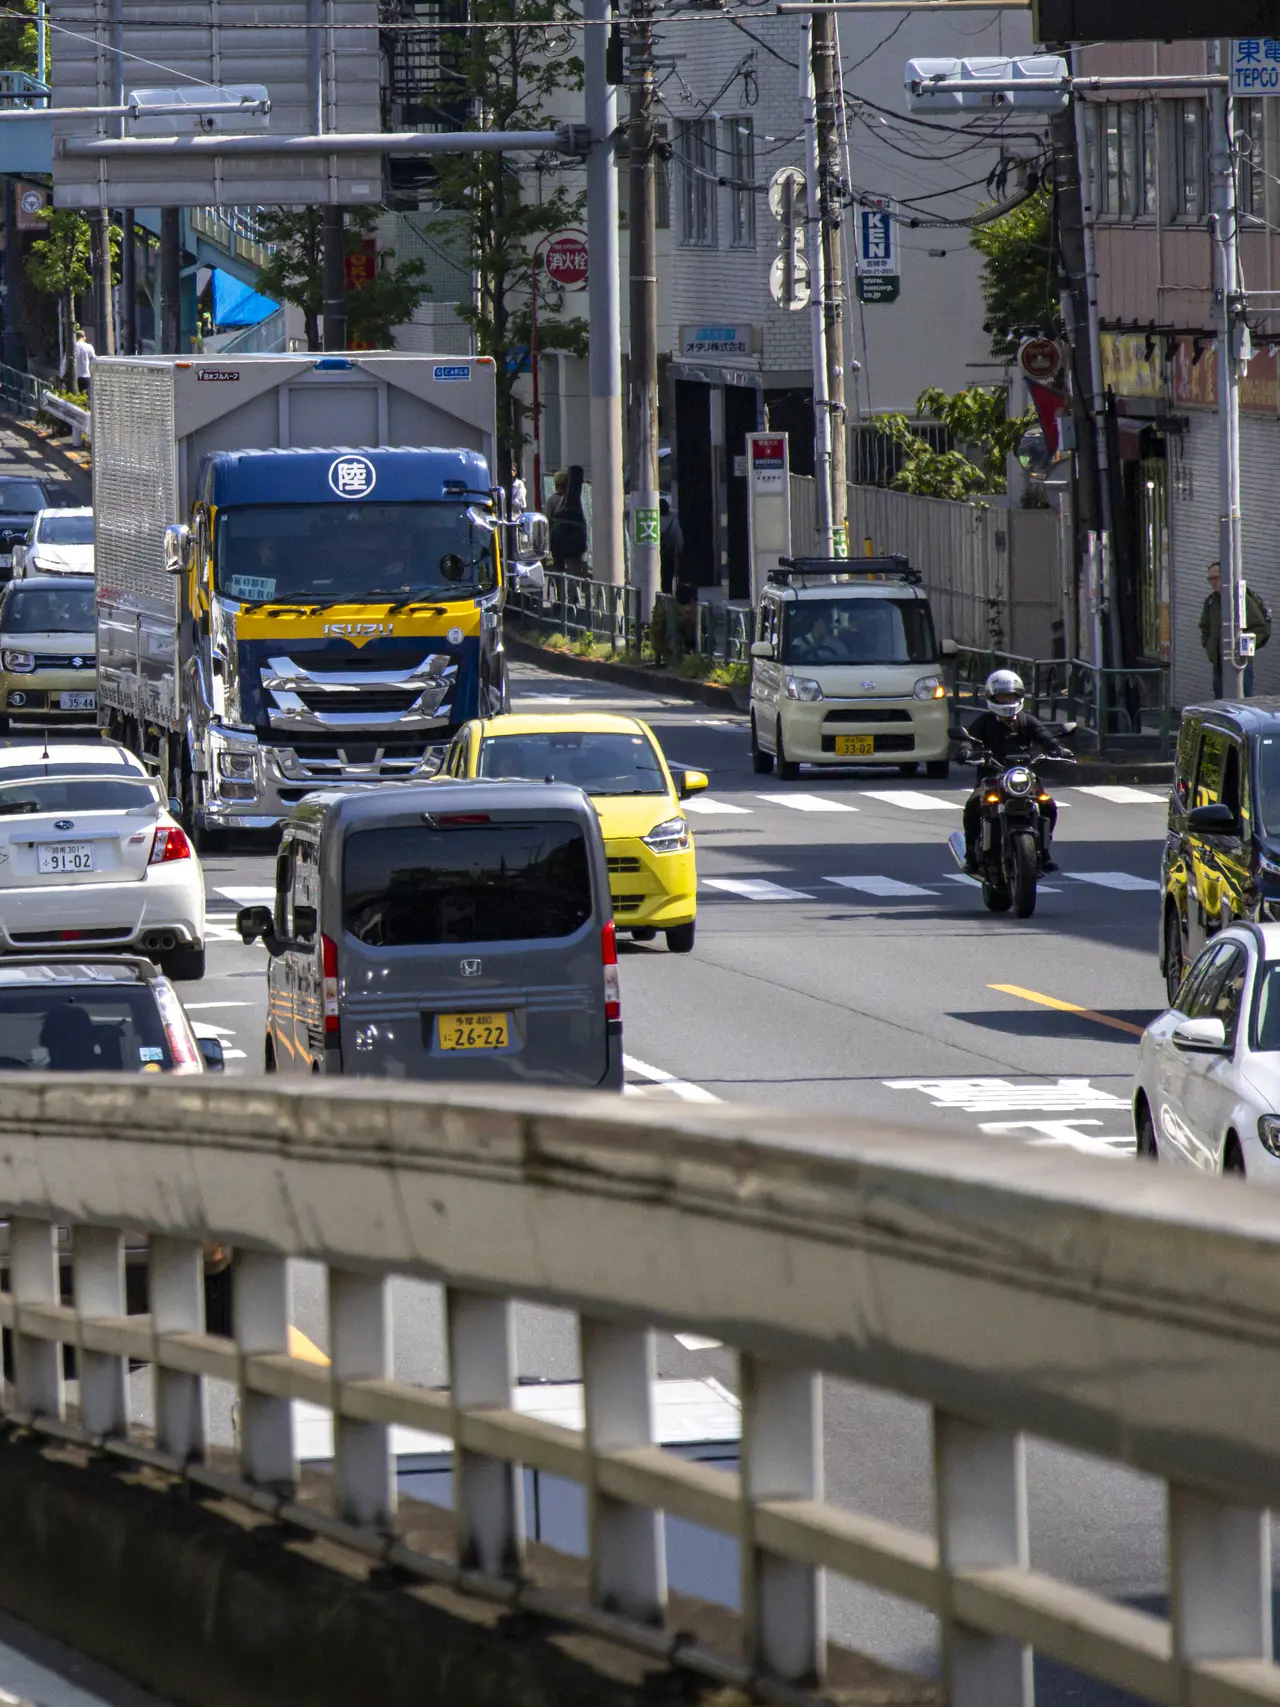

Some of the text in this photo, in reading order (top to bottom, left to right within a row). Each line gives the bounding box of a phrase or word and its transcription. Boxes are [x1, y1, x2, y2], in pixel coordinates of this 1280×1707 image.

[1235, 67, 1279, 87] TEPCO
[868, 213, 885, 258] KEN
[549, 251, 587, 270] 消火栓
[863, 292, 881, 300] co.jp
[686, 342, 747, 353] オタリ株式会社
[337, 461, 368, 491] 陸
[323, 623, 394, 637] ISUZU
[844, 743, 872, 754] 33-02
[51, 854, 91, 869] 91-02
[454, 1026, 505, 1047] 26-22
